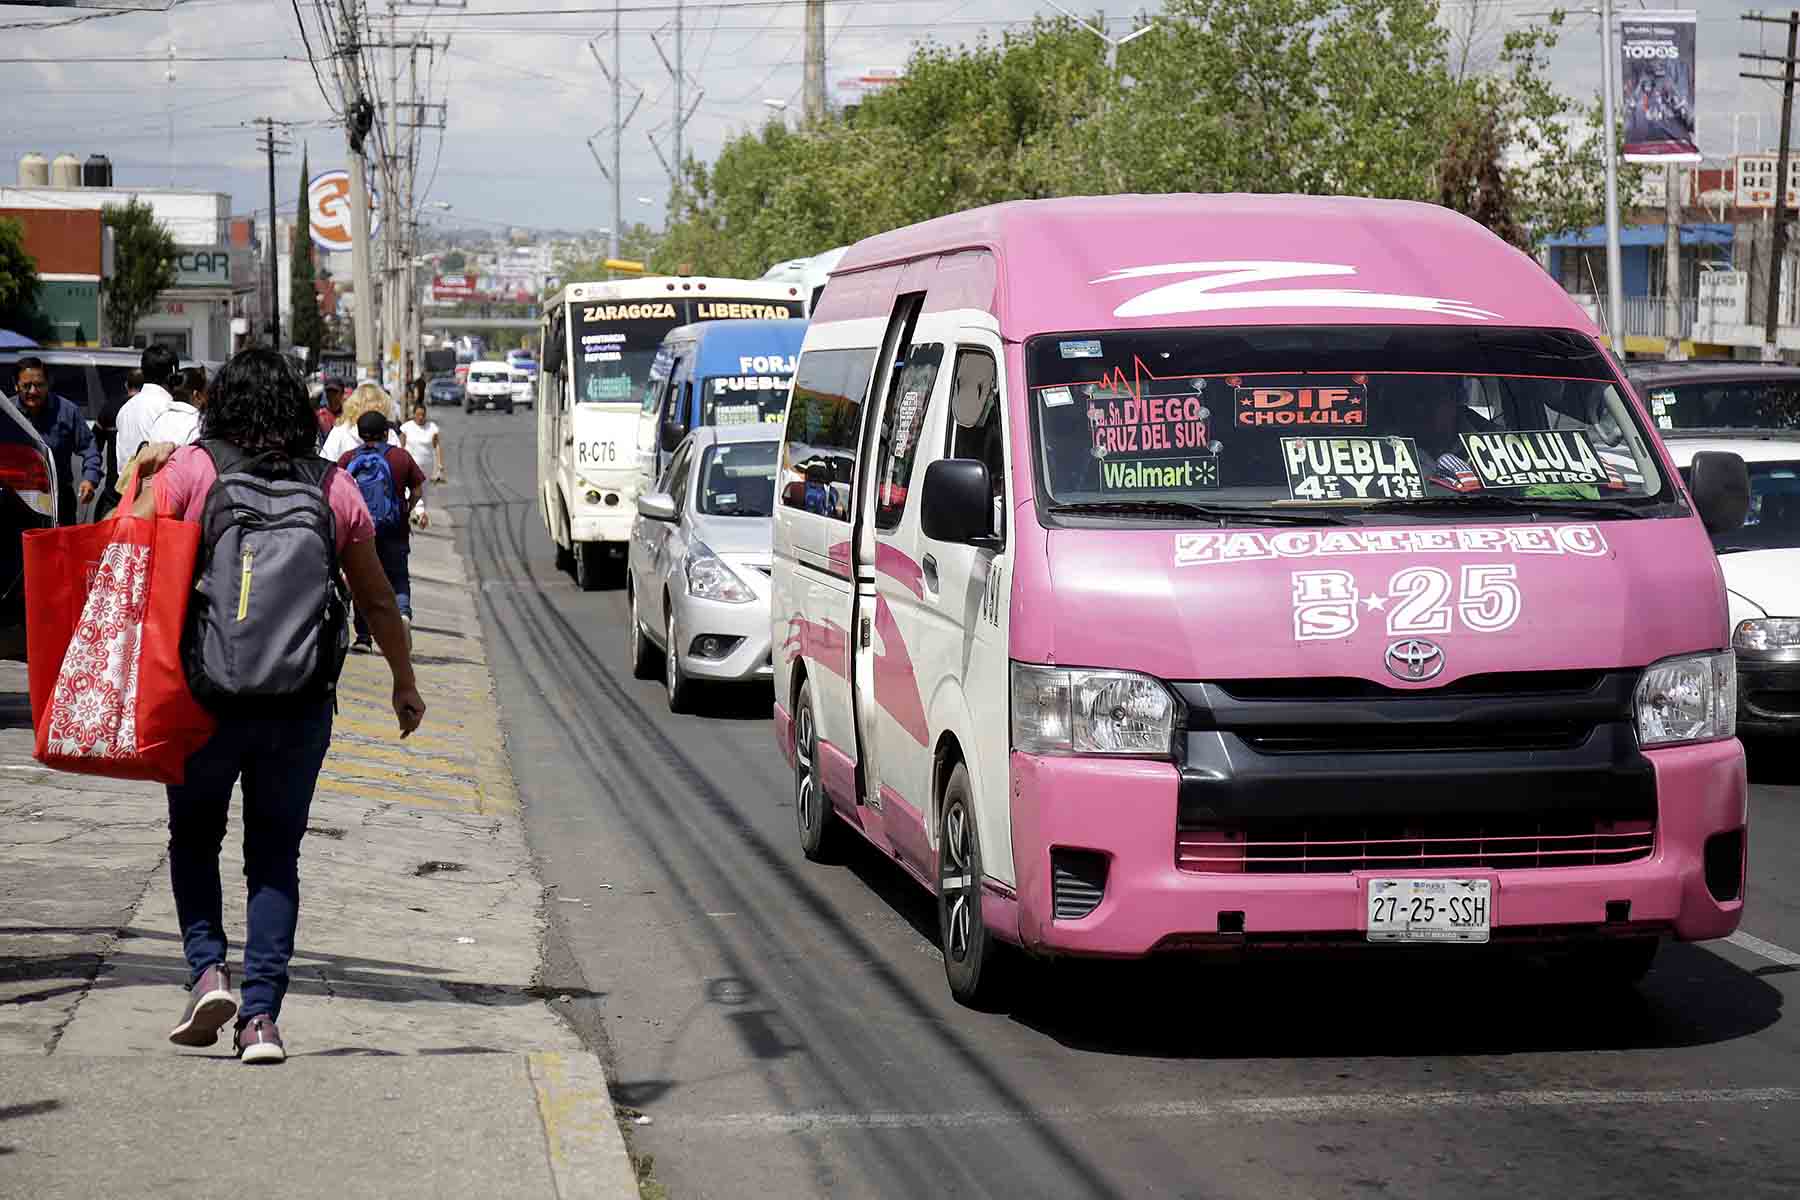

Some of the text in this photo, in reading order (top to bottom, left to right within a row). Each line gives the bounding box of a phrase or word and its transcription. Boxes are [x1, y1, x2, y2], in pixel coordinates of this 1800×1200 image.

[1623, 45, 1679, 59] TODOS
[176, 252, 229, 280] CAR
[583, 303, 790, 322] ZARAGOZA LIBERTAD
[1124, 397, 1200, 425] DIEGO
[1252, 389, 1350, 409] DIF
[1239, 410, 1363, 425] CHOLULA
[1095, 421, 1208, 453] CRUZ DEL SUR
[579, 440, 616, 464] R-C76
[1286, 439, 1418, 475] PUEBLA
[1468, 430, 1607, 480] CHOLULA
[1104, 461, 1193, 488] Walmart
[1295, 475, 1325, 499] 4
[1343, 475, 1374, 498] Y
[1496, 471, 1598, 484] CENTRO
[1175, 525, 1608, 566] ZACATEPEC
[1386, 564, 1521, 637] 25
[1373, 897, 1486, 923] 27-25-SSH
